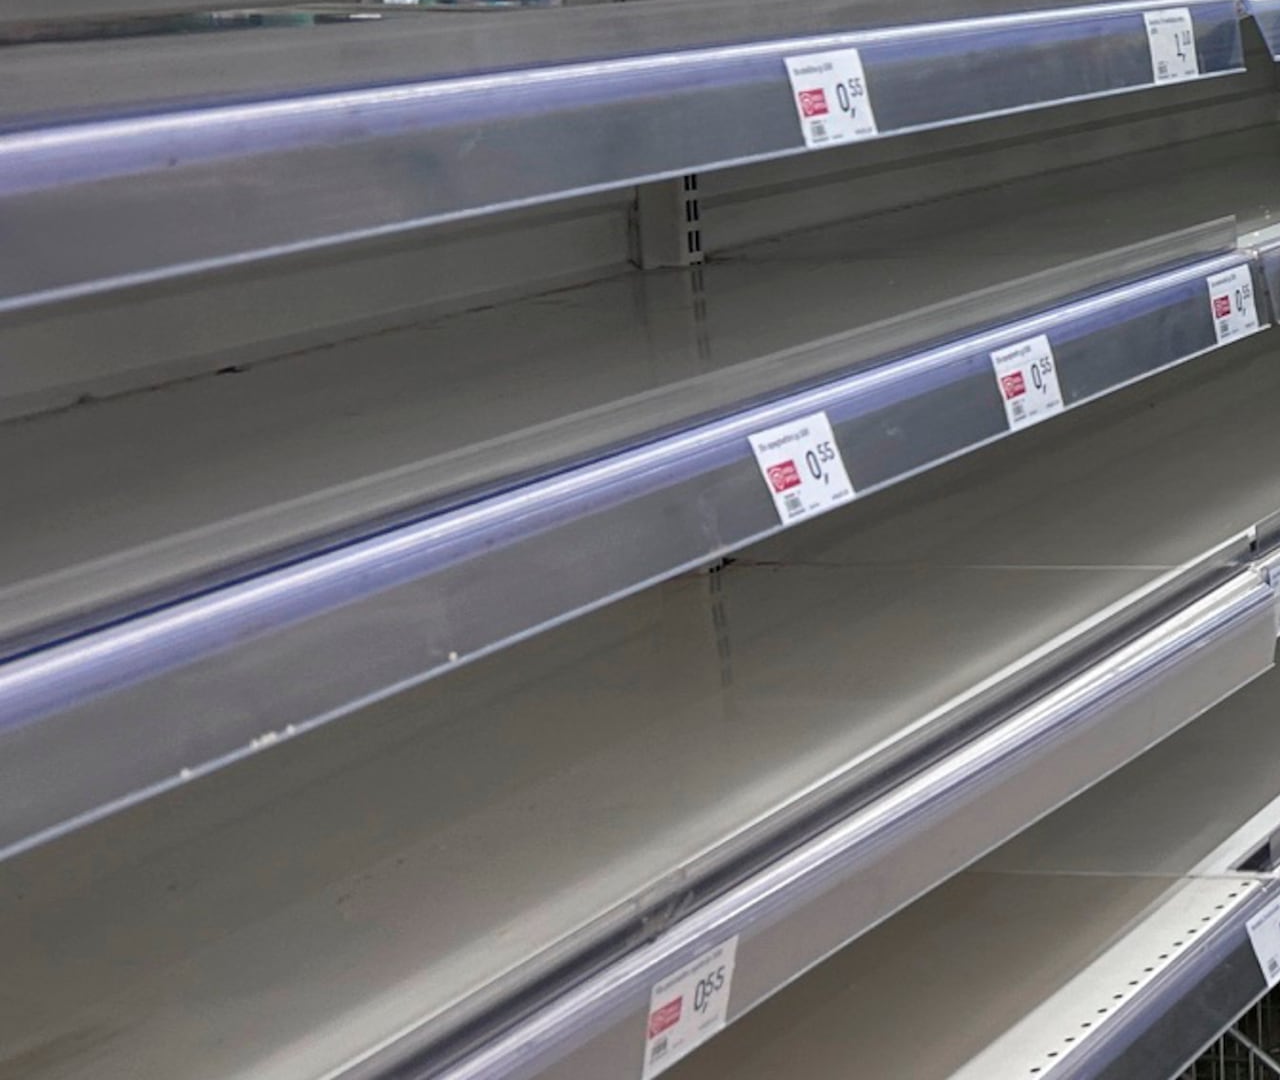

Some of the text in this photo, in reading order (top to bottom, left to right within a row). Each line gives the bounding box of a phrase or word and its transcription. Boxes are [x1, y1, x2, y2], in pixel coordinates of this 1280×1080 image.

[837, 77, 865, 119] 0,55
[1031, 356, 1052, 395] 0,55
[806, 441, 835, 486] 0,55
[694, 965, 726, 1015] 0,55
